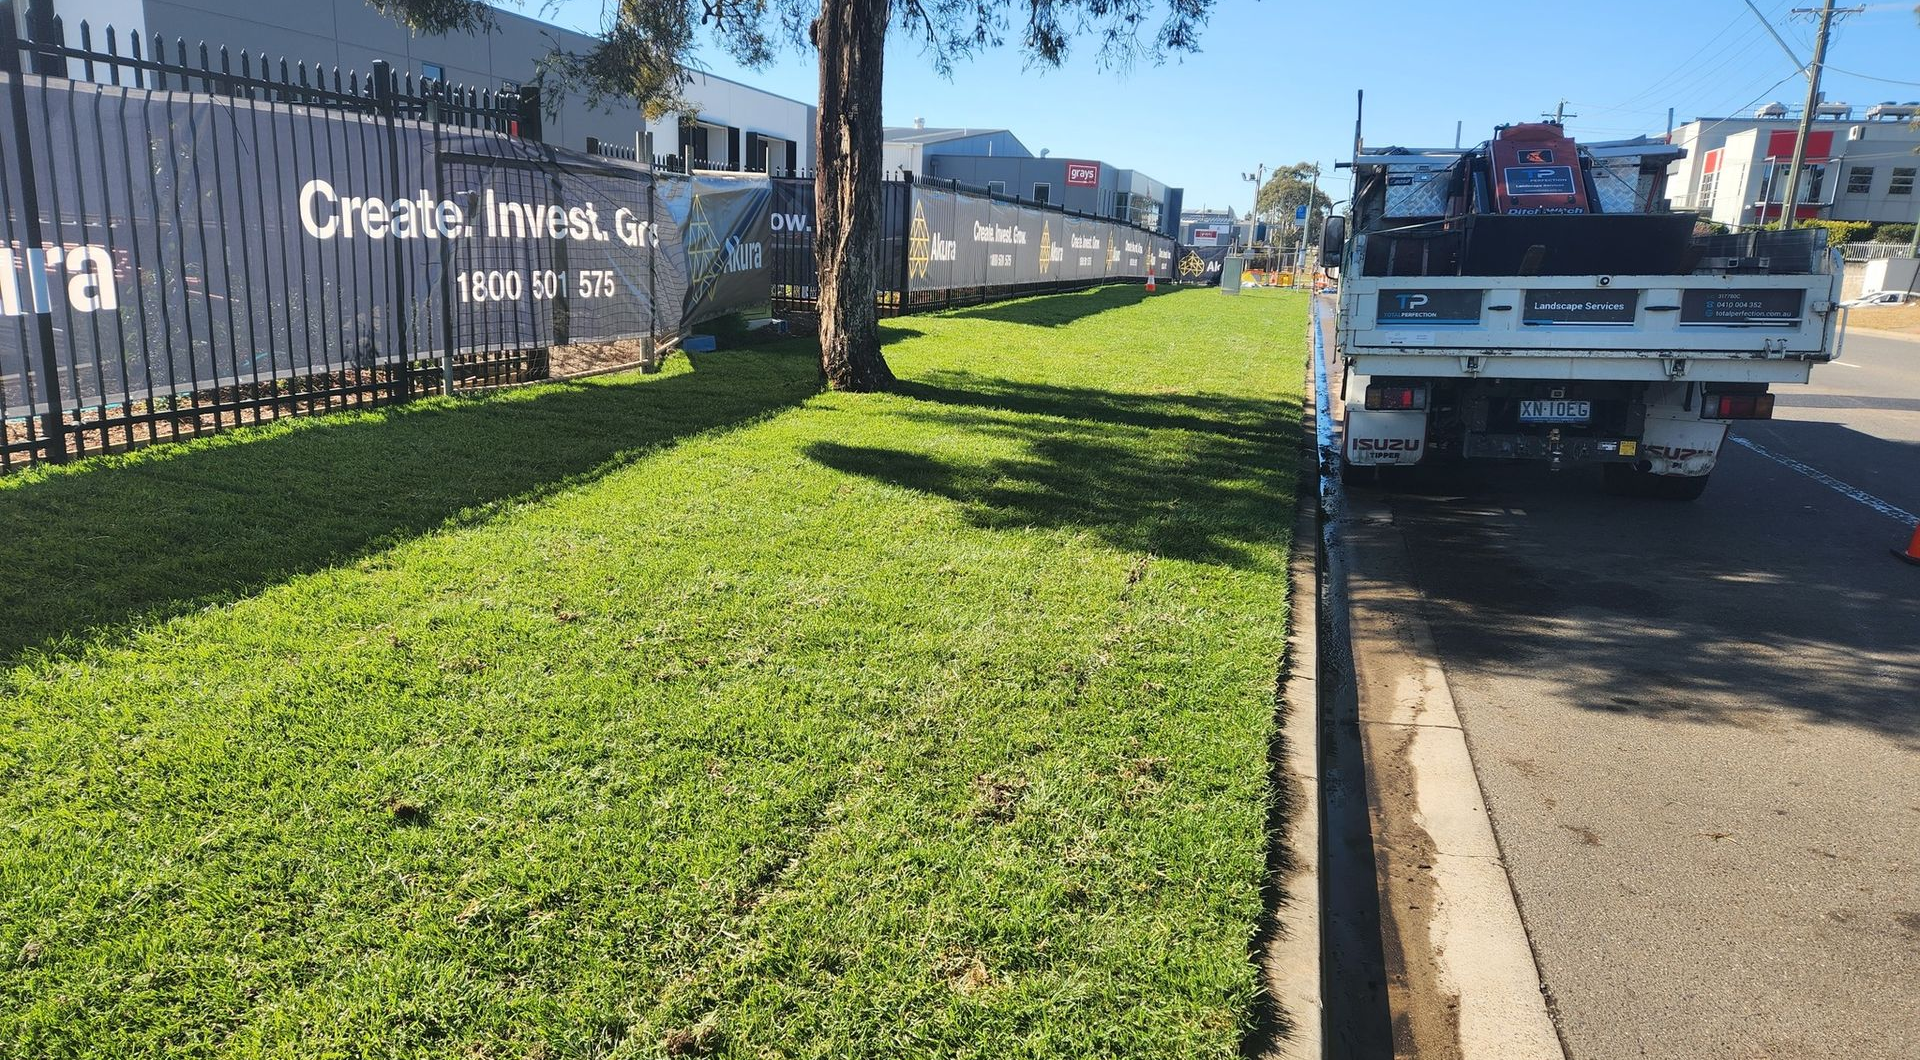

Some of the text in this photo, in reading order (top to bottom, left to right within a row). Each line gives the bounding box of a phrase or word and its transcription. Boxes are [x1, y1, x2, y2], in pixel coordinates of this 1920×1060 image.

[1071, 169, 1094, 180] grays
[300, 179, 472, 240] Create.
[486, 188, 609, 242] Invest.
[723, 235, 762, 274] Akura
[930, 232, 956, 261] Akura
[457, 269, 615, 302] 1800 501 575
[1396, 294, 1428, 310] TP
[1534, 302, 1625, 311] Landscape Services
[1715, 310, 1792, 318] totalperfection.com.au
[1352, 438, 1420, 451] ISUZU
